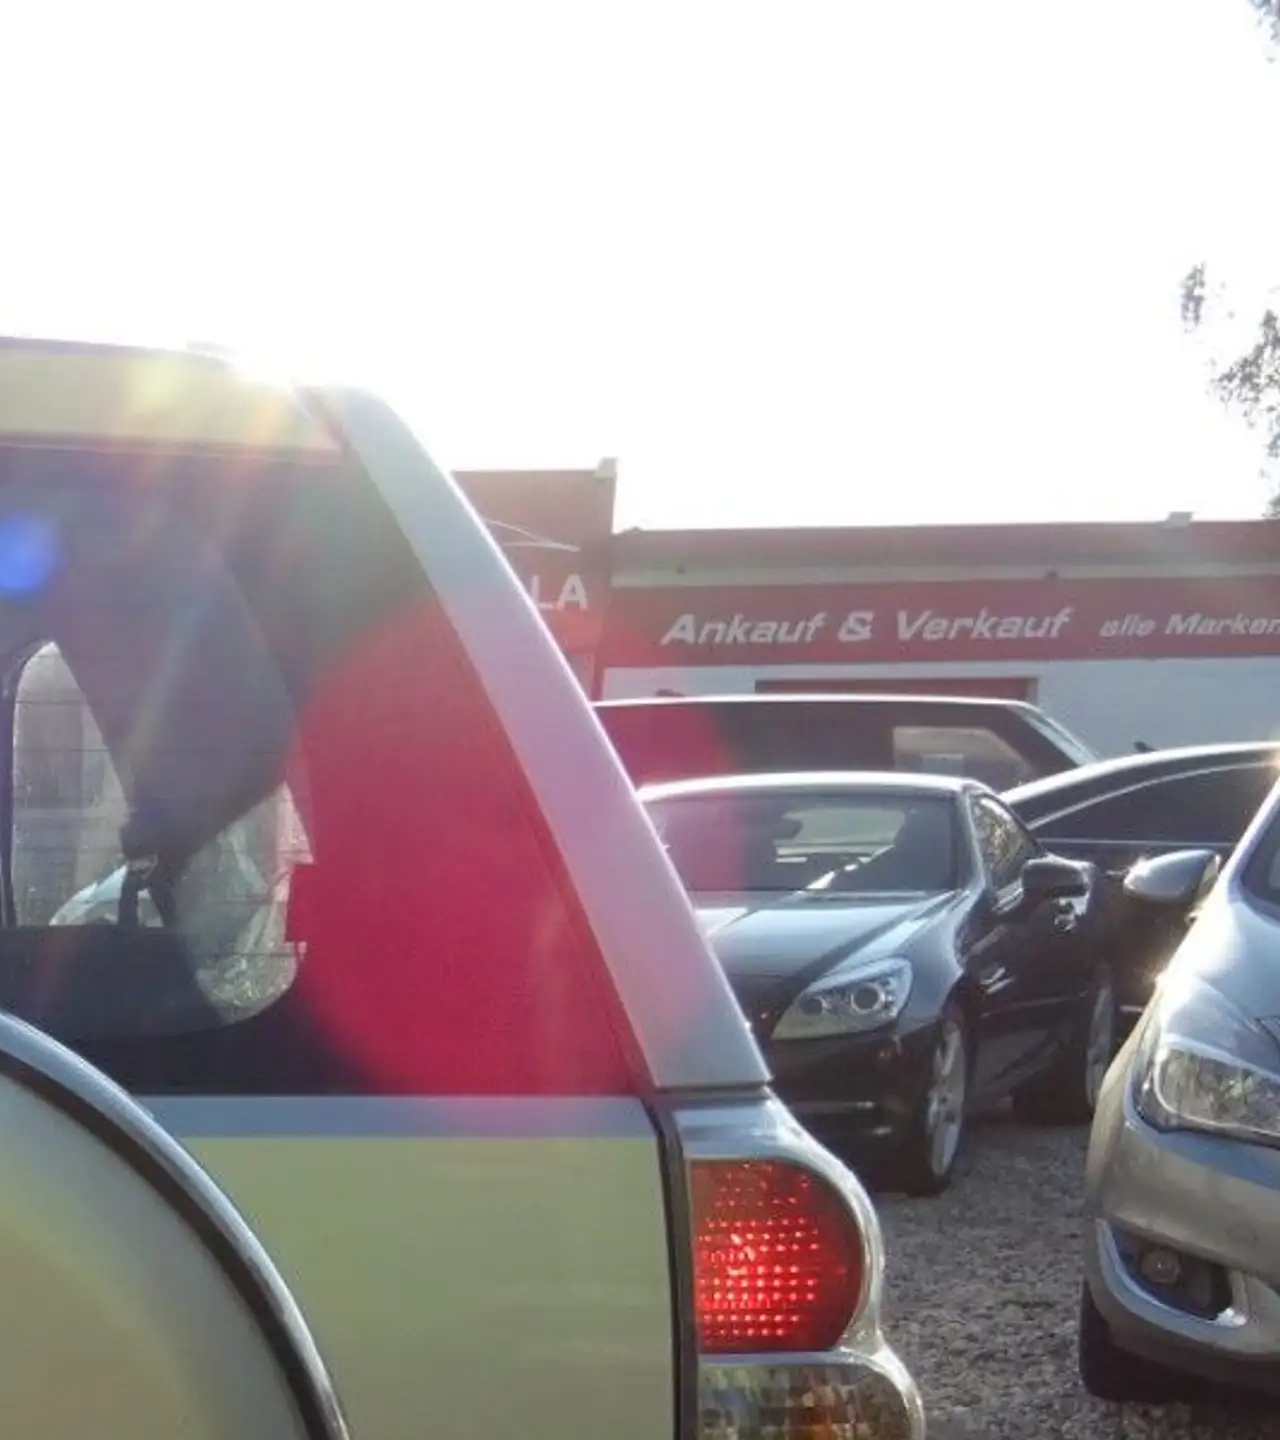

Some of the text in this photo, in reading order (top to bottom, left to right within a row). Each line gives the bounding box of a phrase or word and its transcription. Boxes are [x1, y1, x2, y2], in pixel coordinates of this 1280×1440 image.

[530, 573, 589, 611] LA
[660, 612, 827, 645] Ankauf
[836, 611, 874, 642] &
[895, 606, 1074, 641] Verkauf
[1098, 612, 1158, 637] alle
